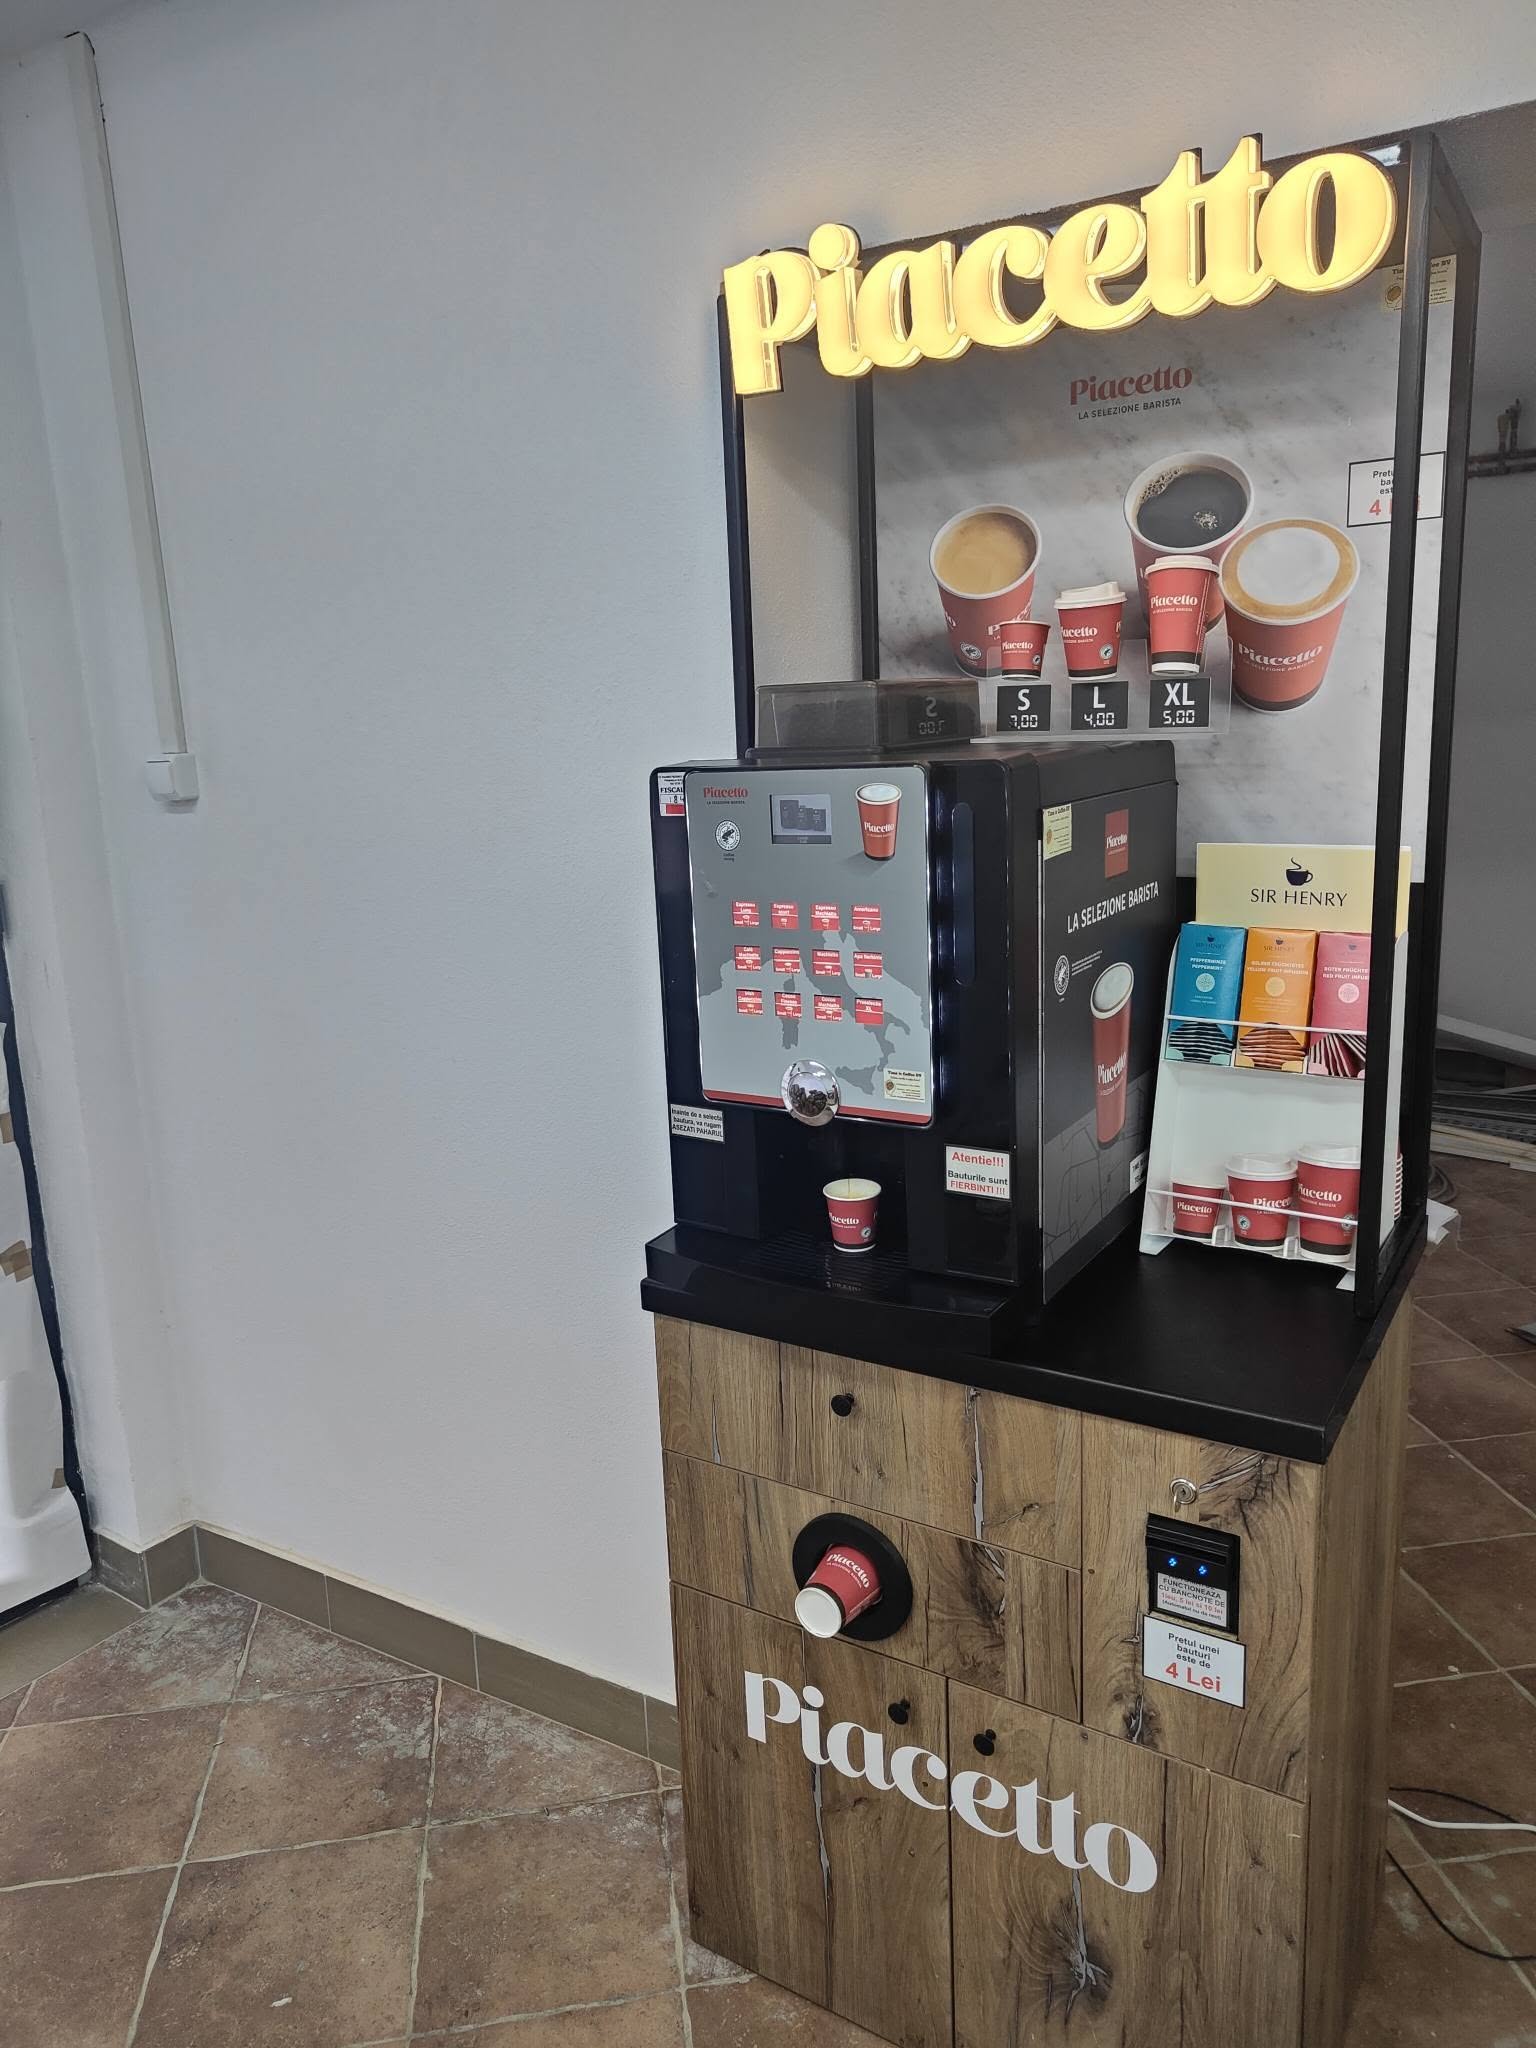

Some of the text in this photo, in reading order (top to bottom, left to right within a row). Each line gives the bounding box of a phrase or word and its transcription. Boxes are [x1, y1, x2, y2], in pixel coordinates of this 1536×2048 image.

[1070, 365, 1193, 405] Piacetto
[1078, 397, 1181, 420] LA SELEZIONE BARISTA
[1150, 594, 1198, 608] Piacetto
[1238, 643, 1323, 666] Piacetto
[1017, 688, 1031, 711] S
[1093, 686, 1106, 709] L
[1164, 682, 1195, 706] XL
[703, 786, 748, 798] Piacetto
[863, 821, 896, 833] Piacetto
[1067, 881, 1159, 934] LA SELEZIONE BARISTA
[1250, 888, 1348, 907] SIR HENRY
[672, 1123, 725, 1138] ASEZATI PAHARUL
[952, 1151, 1004, 1167] Atentie!!!
[947, 1169, 1009, 1186] Bauturile sunt
[950, 1180, 994, 1194] FIERBINTI
[1177, 1201, 1213, 1214] Piacetto
[1158, 1584, 1225, 1608] CU BANCNOTE DE
[1163, 1578, 1222, 1599] FUNCTIONEAZA
[1168, 1632, 1220, 1655] Pretul unei
[1176, 1643, 1211, 1661] bauturi
[1176, 1653, 1211, 1669] este de
[1165, 1662, 1221, 1693] 4 Lei
